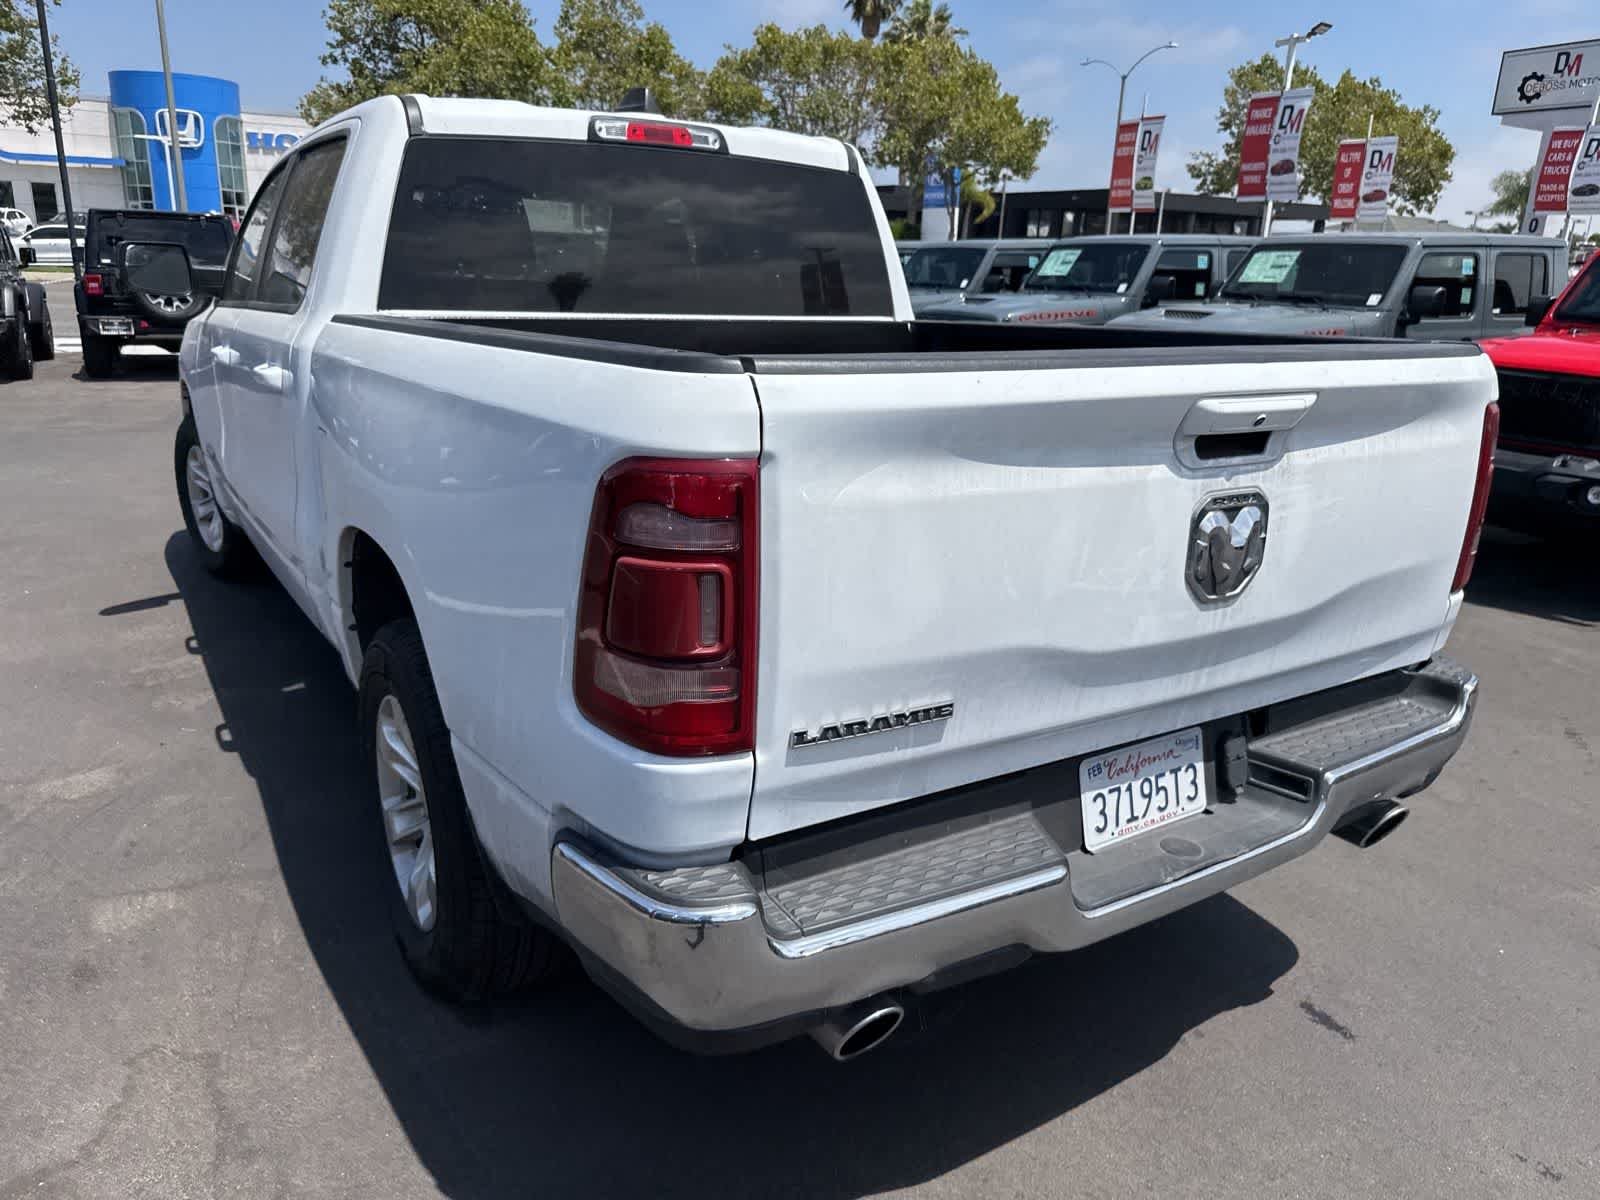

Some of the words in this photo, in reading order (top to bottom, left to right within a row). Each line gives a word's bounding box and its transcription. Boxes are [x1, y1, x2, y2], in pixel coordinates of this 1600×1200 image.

[1562, 138, 1579, 149] BUY
[1548, 152, 1565, 162] CARS
[1543, 165, 1570, 175] TRUCKS
[791, 702, 954, 748] LARAMIE
[1087, 764, 1103, 780] FEB
[1107, 750, 1182, 780] California
[1092, 762, 1198, 833] 37195T3
[1118, 810, 1179, 834] dmv.ca.gov
